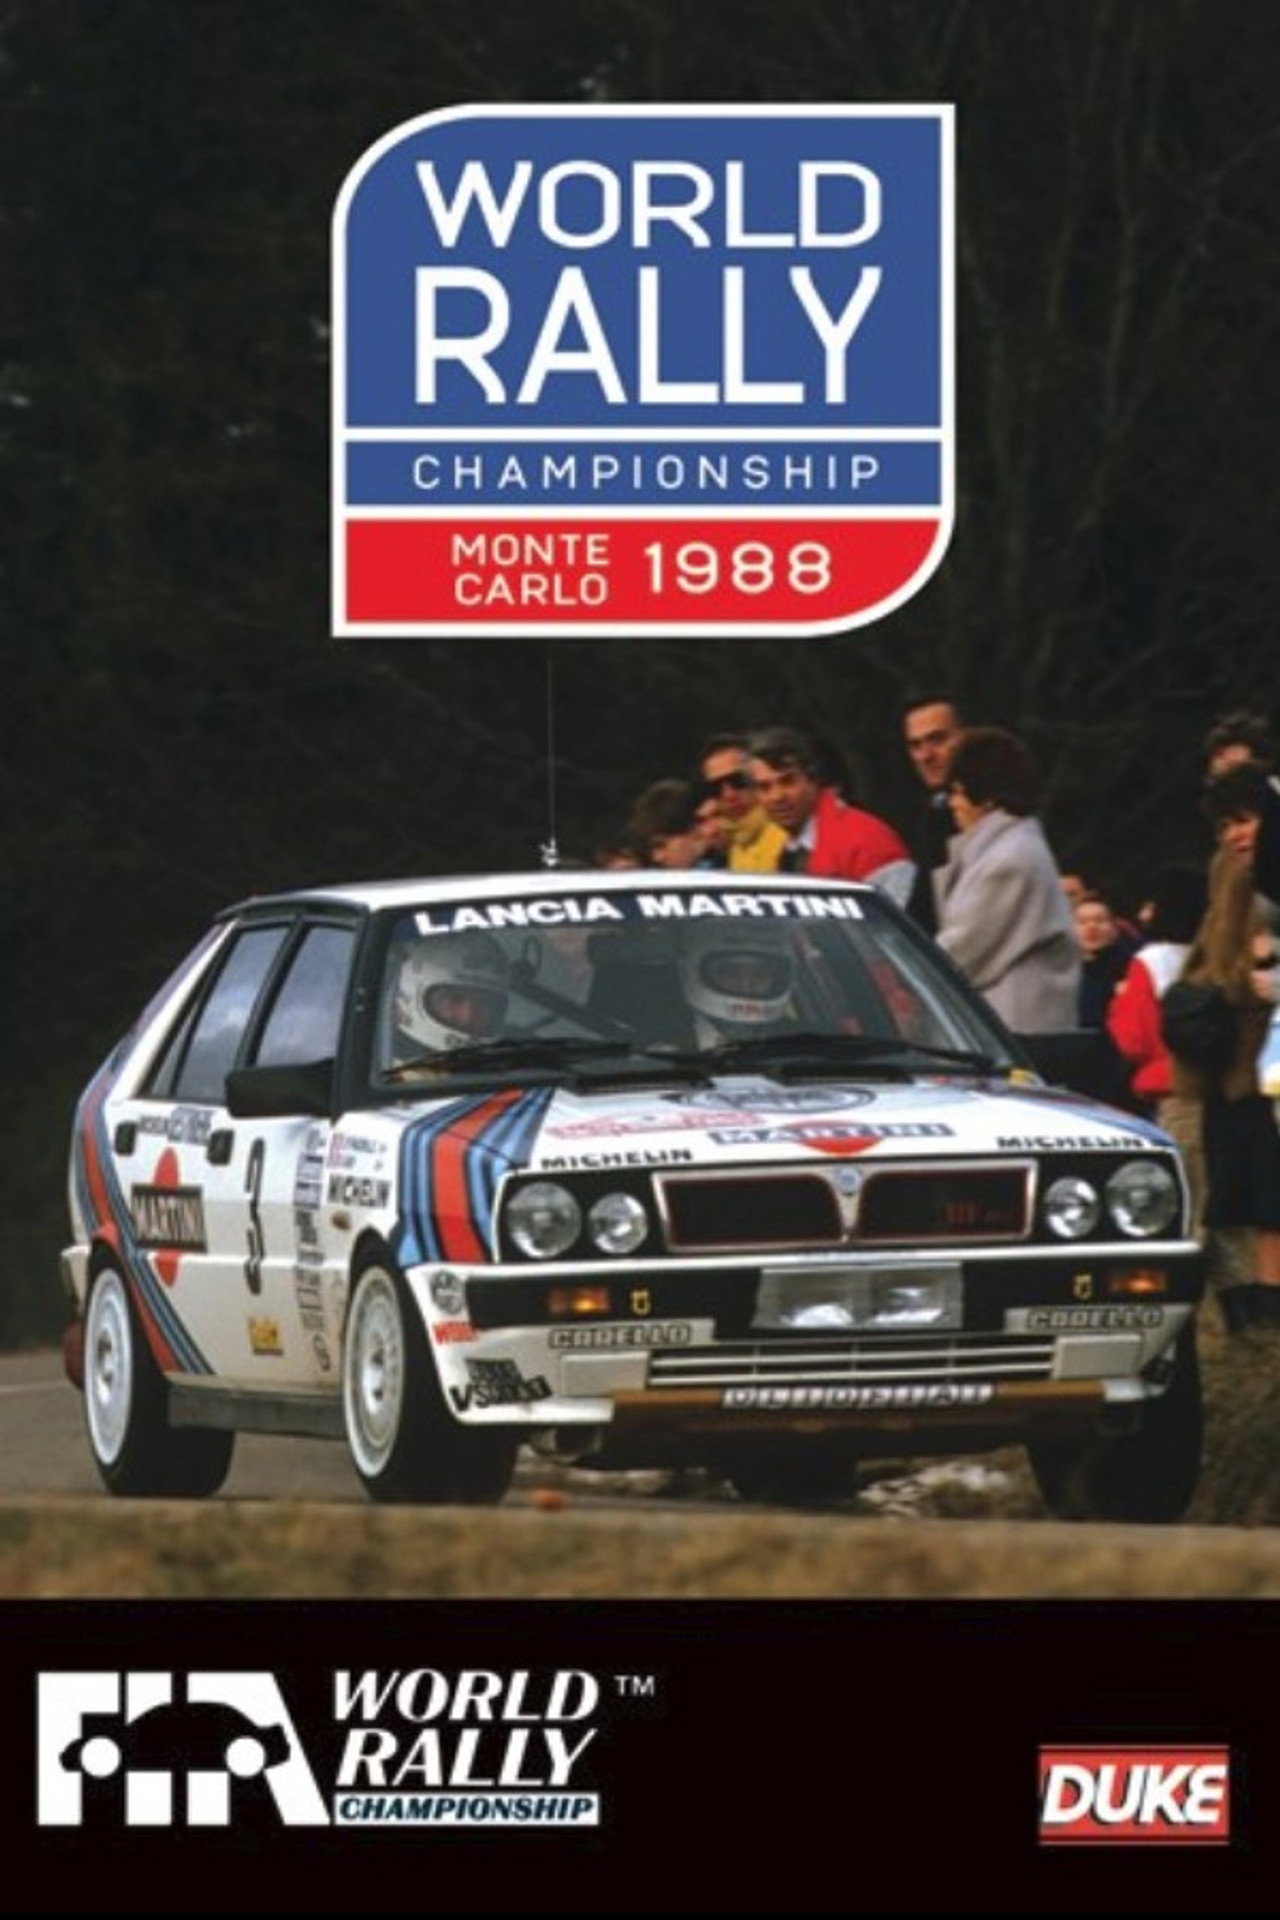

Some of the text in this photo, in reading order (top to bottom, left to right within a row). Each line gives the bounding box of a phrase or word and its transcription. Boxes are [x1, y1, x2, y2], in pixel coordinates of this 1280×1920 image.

[414, 893, 866, 937] LANCIA MARTINI
[709, 1122, 954, 1146] MARTINI
[997, 1134, 1145, 1149] MICHELIN
[540, 1149, 694, 1170] MICHELIN
[131, 1191, 206, 1245] MARTINI
[244, 1136, 266, 1296] 3
